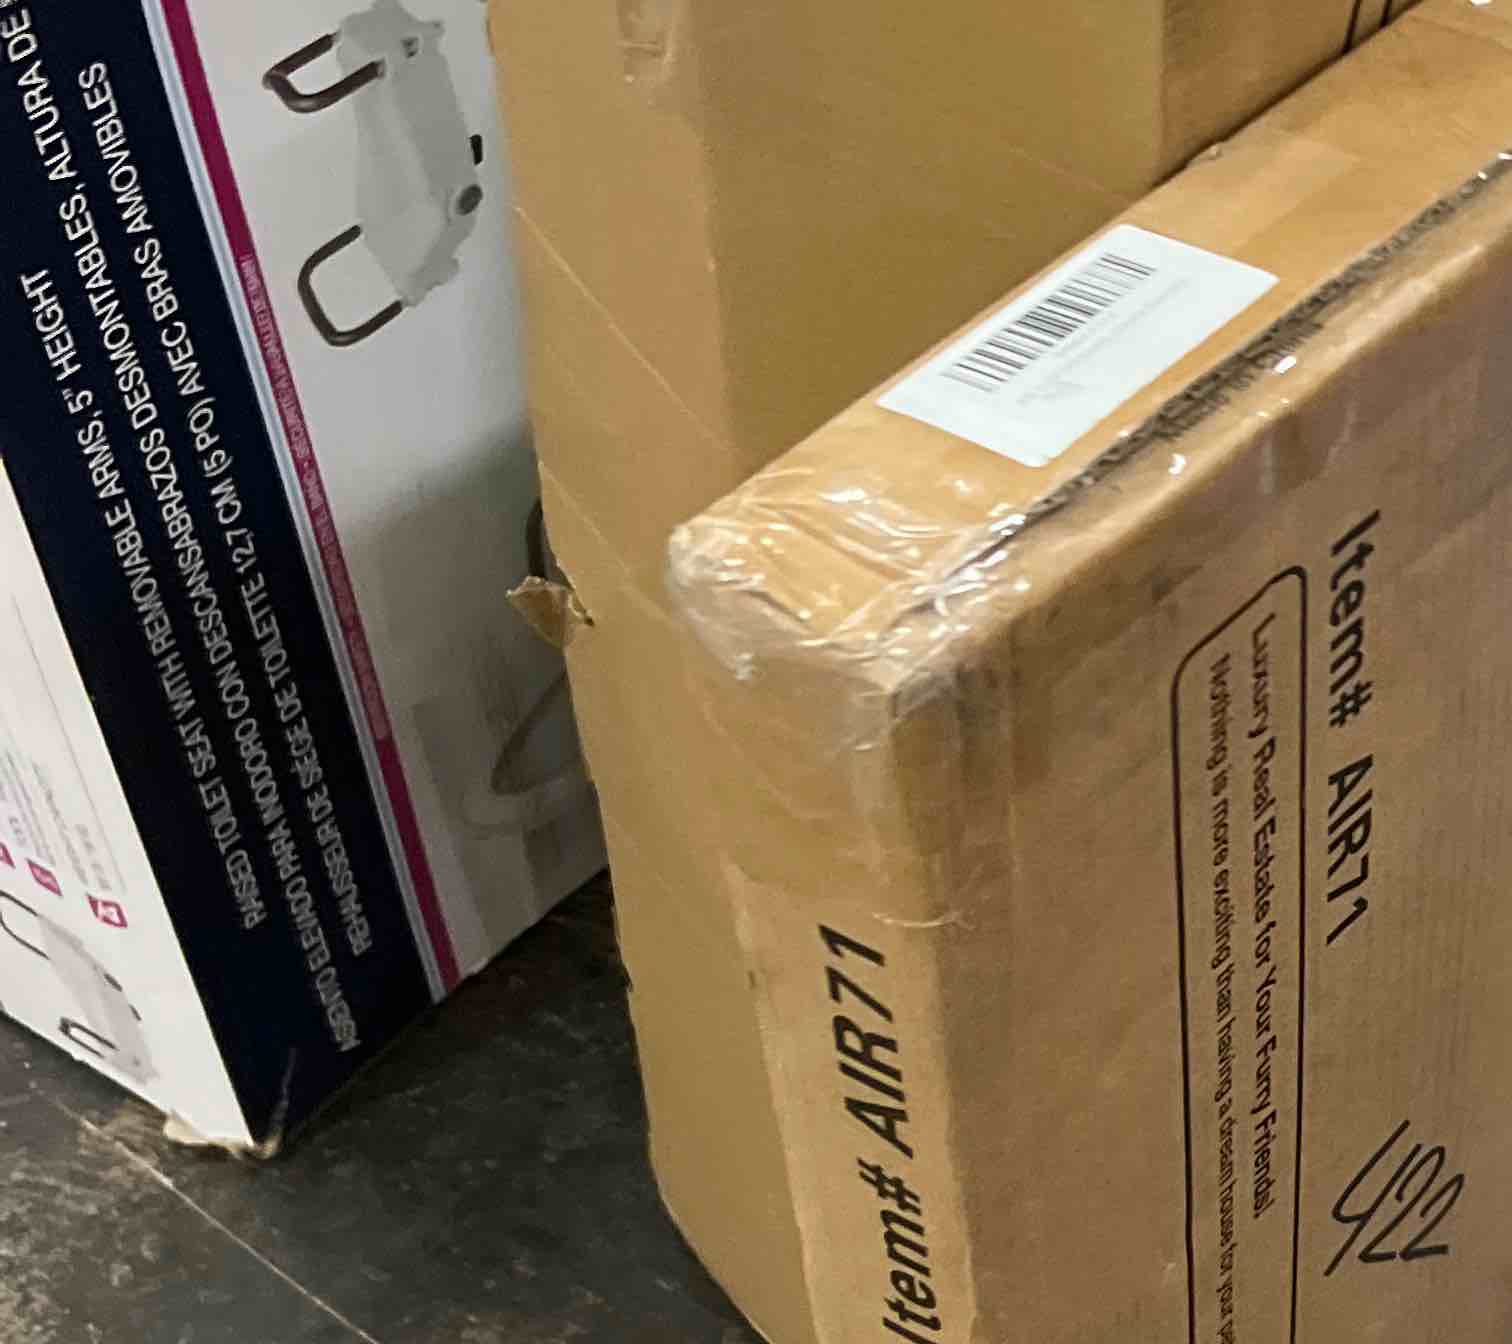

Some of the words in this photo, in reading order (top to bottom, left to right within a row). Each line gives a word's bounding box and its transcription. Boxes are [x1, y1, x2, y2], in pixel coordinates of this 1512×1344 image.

[0, 8, 39, 64] DE
[17, 59, 79, 182] ALTURA
[78, 61, 154, 235] AMOVIBLES
[58, 182, 158, 430] DESMONTABLES,
[133, 236, 180, 323] BRAS
[20, 269, 82, 382] HEIGHT
[160, 319, 206, 397] AVEC
[76, 409, 125, 500] ARMS,
[186, 396, 221, 453] PO)
[201, 448, 234, 479] (5
[210, 476, 243, 526] CM
[104, 498, 177, 657] REMOVABLE
[139, 427, 233, 665] DESCANSABRAZOS
[240, 570, 292, 689] TOILETTE
[1327, 507, 1384, 730] Item#
[157, 651, 197, 721] WITH
[215, 659, 251, 721] CON
[273, 680, 302, 724] DE
[1206, 652, 1234, 771] Nothing
[1247, 611, 1277, 740] Luxury
[177, 716, 217, 779] SEAT
[233, 716, 286, 827] INODORO
[1253, 735, 1278, 822] Real
[199, 774, 242, 856] TOILET
[306, 782, 335, 823] DE
[1212, 797, 1230, 868] more
[225, 848, 268, 930] RAISED
[267, 817, 303, 882] PARA
[315, 816, 374, 957] REHAUSSEUR
[1253, 815, 1278, 924] Estate
[1324, 754, 1375, 947] AIR71
[285, 875, 331, 974] ELEVADO
[1210, 868, 1235, 970] exciting
[1254, 919, 1278, 969] for
[1215, 961, 1236, 1024] than
[1255, 964, 1278, 1041] Your
[818, 921, 914, 1159] AIR71
[1213, 1016, 1237, 1103] having
[1250, 1033, 1278, 1115] Furry
[1252, 1108, 1278, 1221] Friends!
